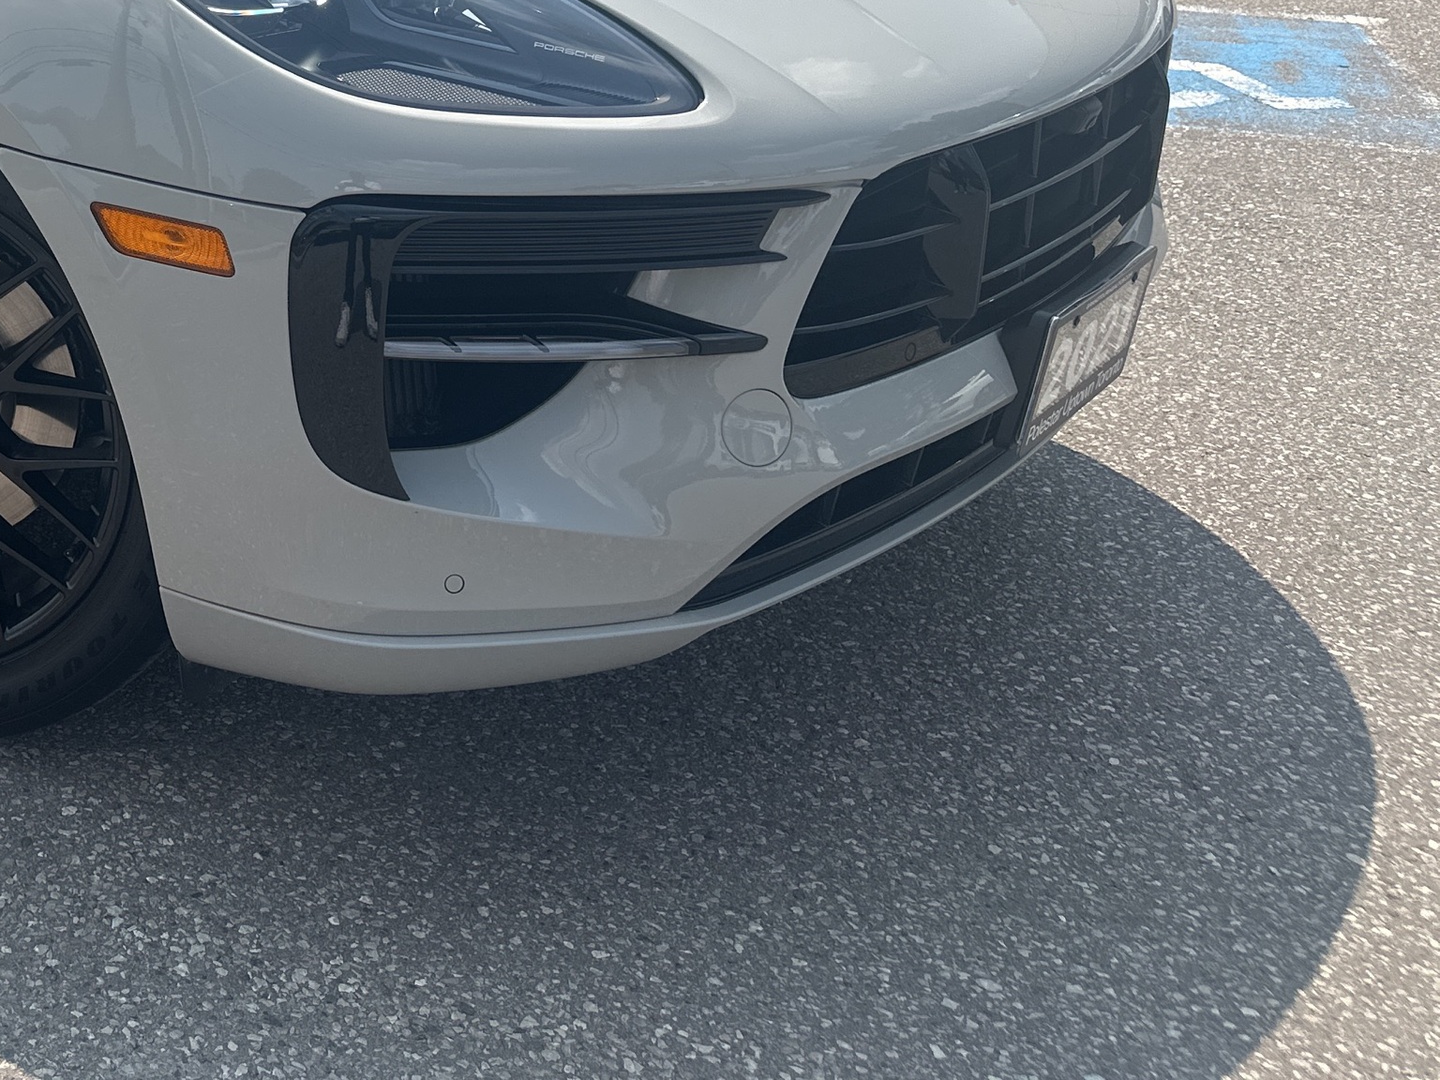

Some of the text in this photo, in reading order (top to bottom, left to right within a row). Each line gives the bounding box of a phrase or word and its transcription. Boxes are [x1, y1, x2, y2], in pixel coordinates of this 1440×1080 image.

[534, 41, 605, 63] PORSCHE
[1035, 284, 1140, 417] 2021
[1025, 404, 1064, 446] Polestar
